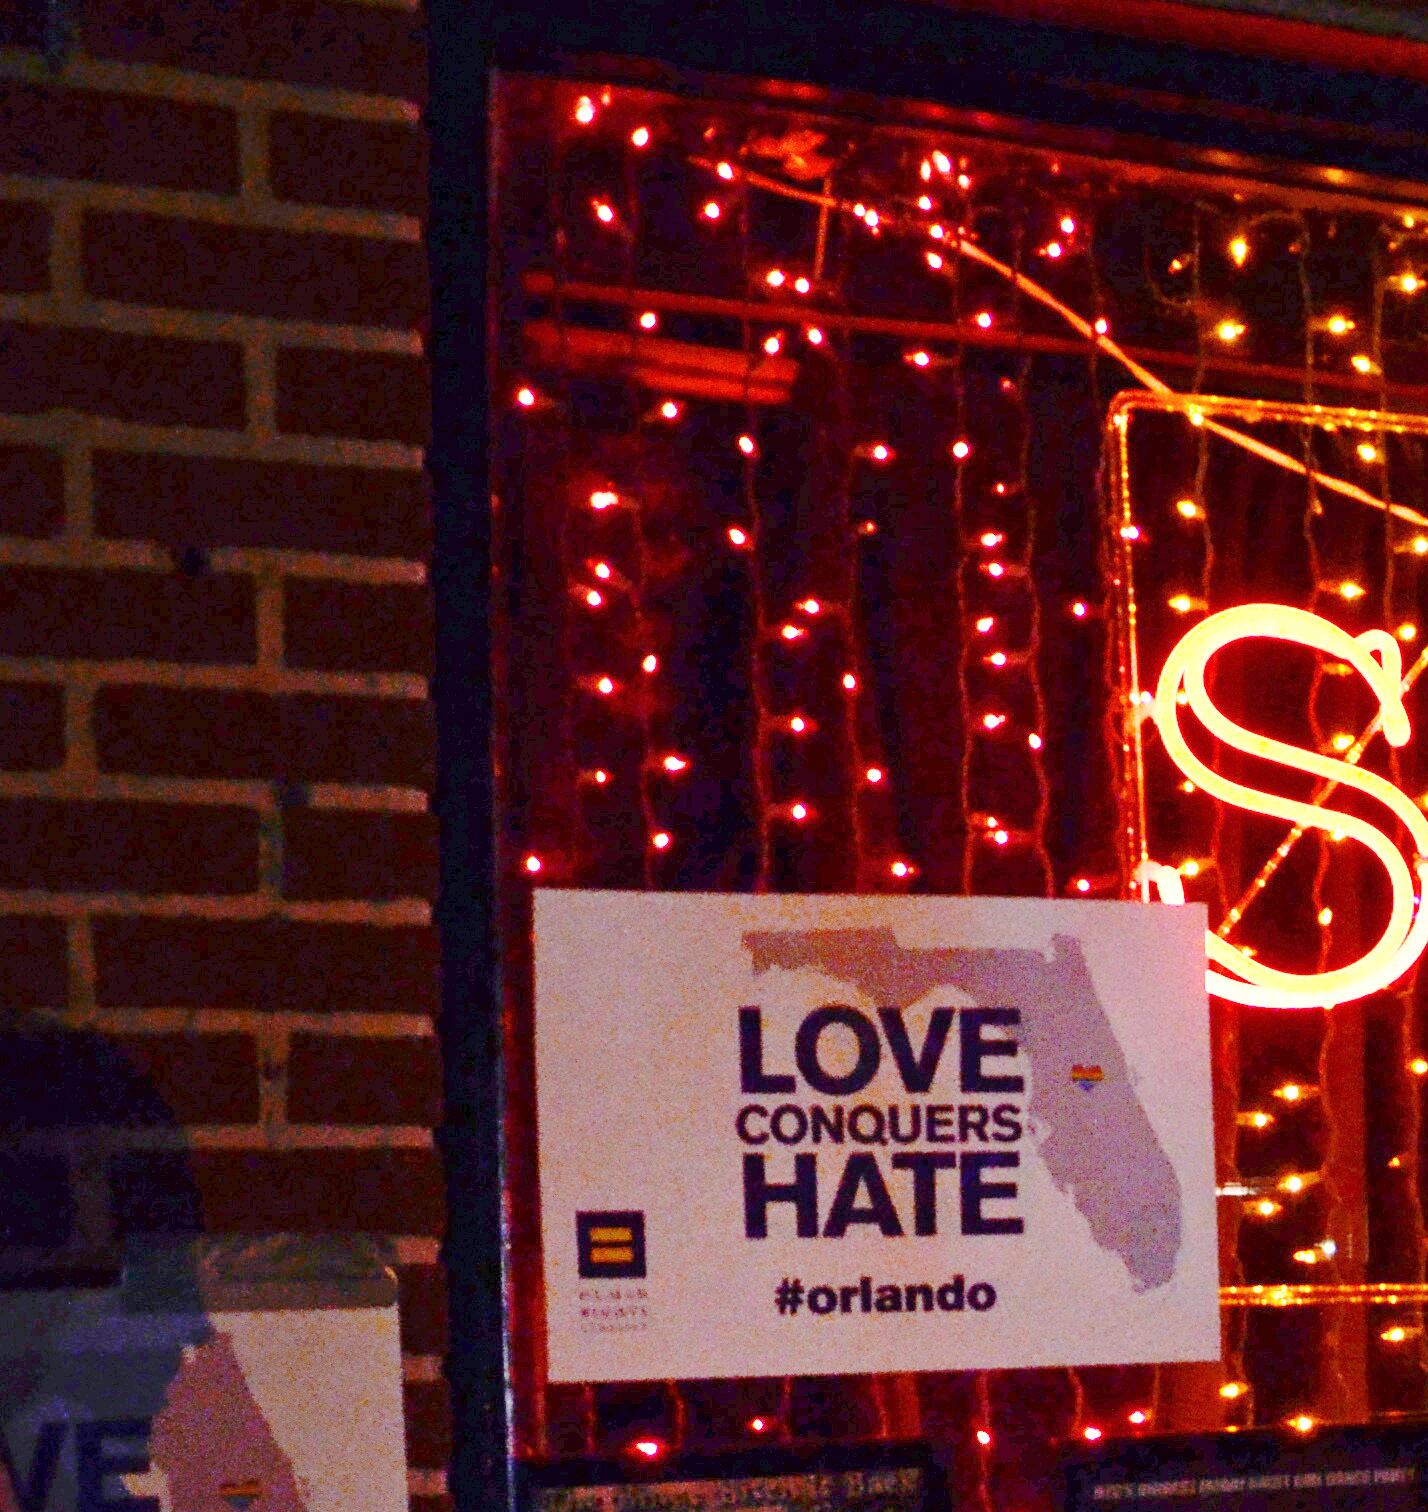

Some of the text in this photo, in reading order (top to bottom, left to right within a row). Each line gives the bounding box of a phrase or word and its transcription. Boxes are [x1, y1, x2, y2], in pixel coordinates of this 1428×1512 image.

[737, 1005, 1025, 1096] LOVE
[735, 1103, 1024, 1147] CONQUERS
[743, 1151, 1026, 1242] HATE
[774, 1274, 998, 1316] #orlando
